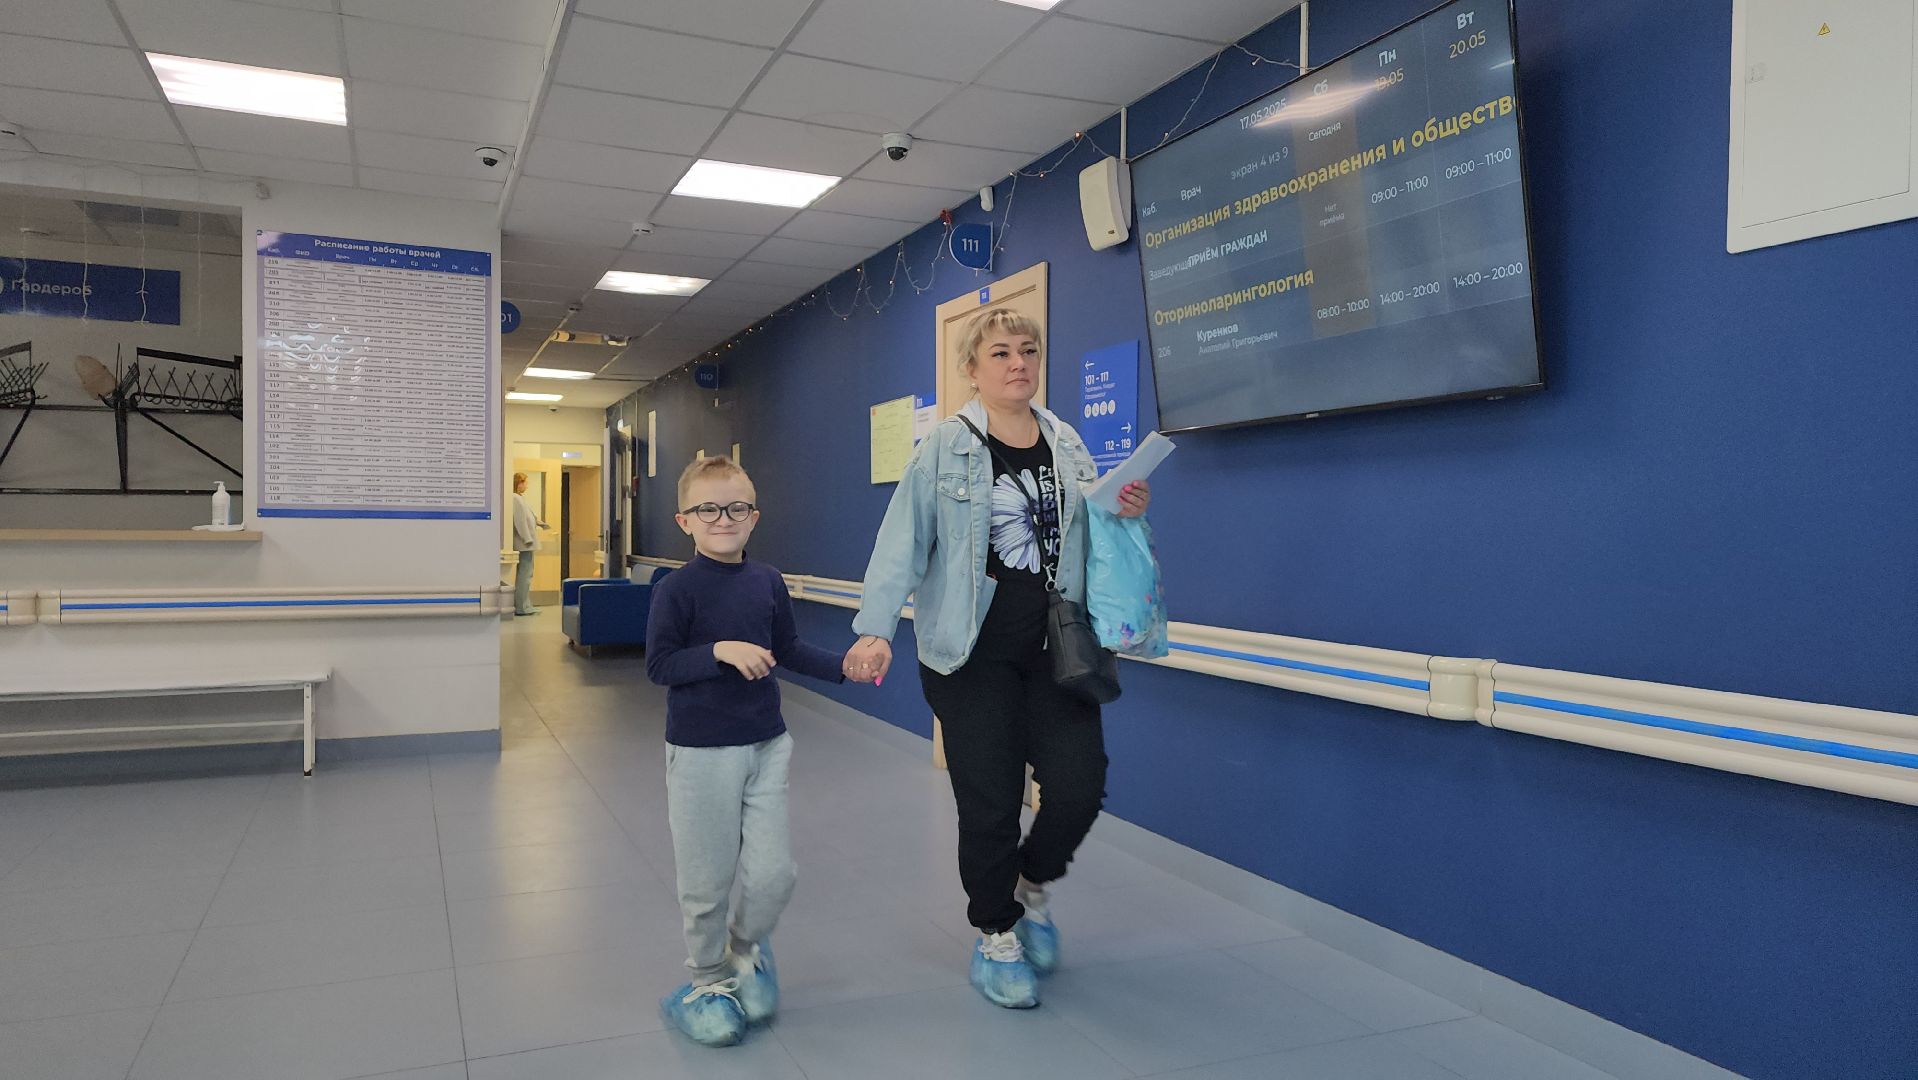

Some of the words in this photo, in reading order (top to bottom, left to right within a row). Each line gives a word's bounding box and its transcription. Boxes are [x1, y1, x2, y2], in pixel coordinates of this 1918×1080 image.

[1456, 11, 1475, 30] Вт
[1449, 30, 1487, 59] 20.05
[1378, 49, 1397, 67] Пн
[1308, 122, 1342, 141] Сегодня
[1145, 204, 1231, 248] Организация
[1234, 144, 1386, 215] здравоохранения
[1392, 136, 1405, 156] и
[1411, 95, 1516, 148] обществ
[1230, 163, 1258, 180] экран
[1259, 155, 1267, 168] 4
[1268, 151, 1281, 165] из
[1282, 146, 1289, 159] 9
[1445, 160, 1475, 179] 09:00
[1484, 147, 1512, 166] 11:00
[1180, 185, 1202, 201] Врач
[1371, 186, 1397, 203] 09:00
[1405, 175, 1429, 193] 11:00
[314, 239, 370, 251] Расписание
[372, 245, 407, 256] работы
[408, 249, 441, 259] врачей
[962, 238, 979, 253] 111
[1220, 229, 1268, 256] ГРАЖДАН
[1452, 271, 1481, 289] 14:00
[1491, 262, 1523, 280] 20:00
[12, 279, 92, 296] Гардероб
[1154, 269, 1314, 326] Оториноларингология
[1380, 291, 1404, 305] 14:00
[1412, 281, 1440, 298] 20:00
[1317, 305, 1340, 320] 08:00
[1347, 298, 1370, 313] 10:00
[1196, 324, 1239, 343] Куренков
[1085, 375, 1095, 385] 101
[1105, 439, 1115, 451] 112
